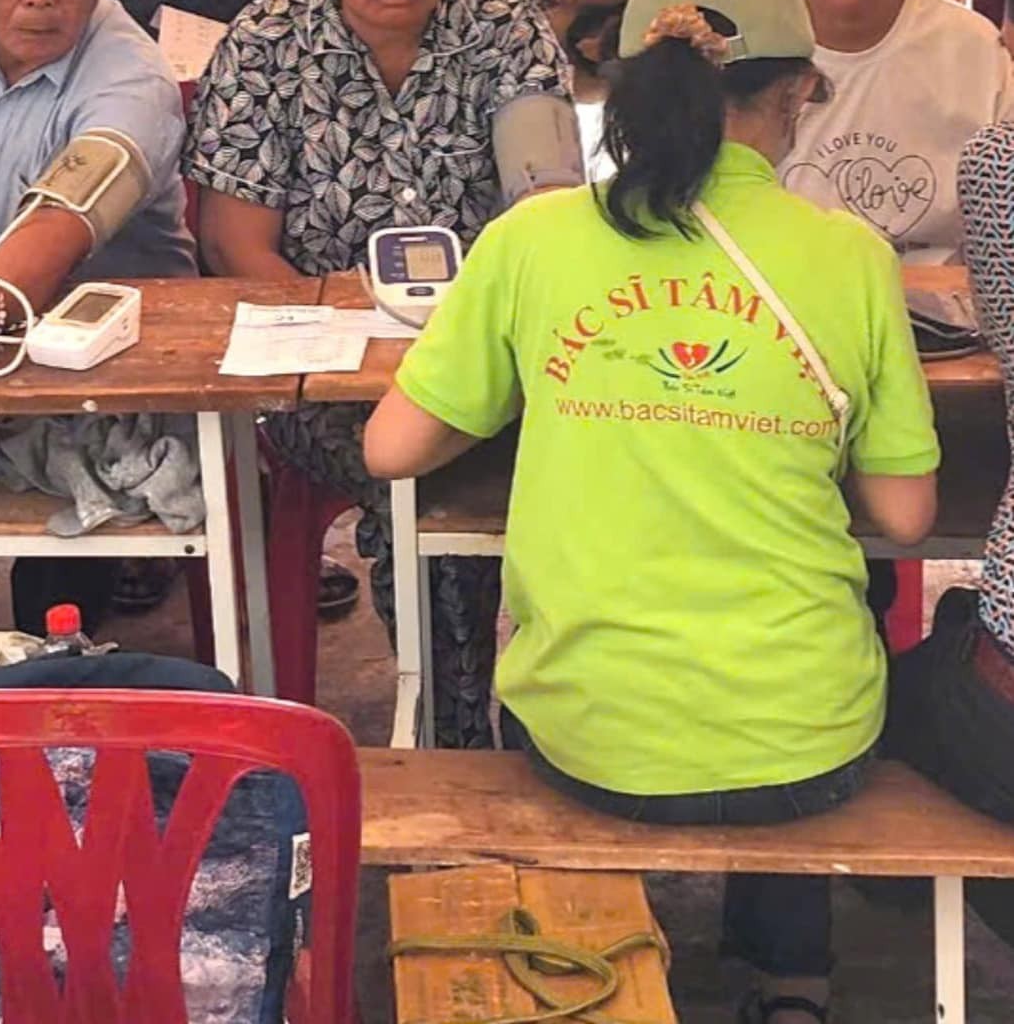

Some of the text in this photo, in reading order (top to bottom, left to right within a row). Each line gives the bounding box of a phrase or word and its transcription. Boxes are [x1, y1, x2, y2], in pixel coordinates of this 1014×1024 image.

[816, 132, 898, 159] I LOVE YOU
[854, 166, 931, 211] love
[545, 305, 604, 384] BÁC
[608, 274, 651, 319] SĨ
[659, 271, 762, 324] TÂM
